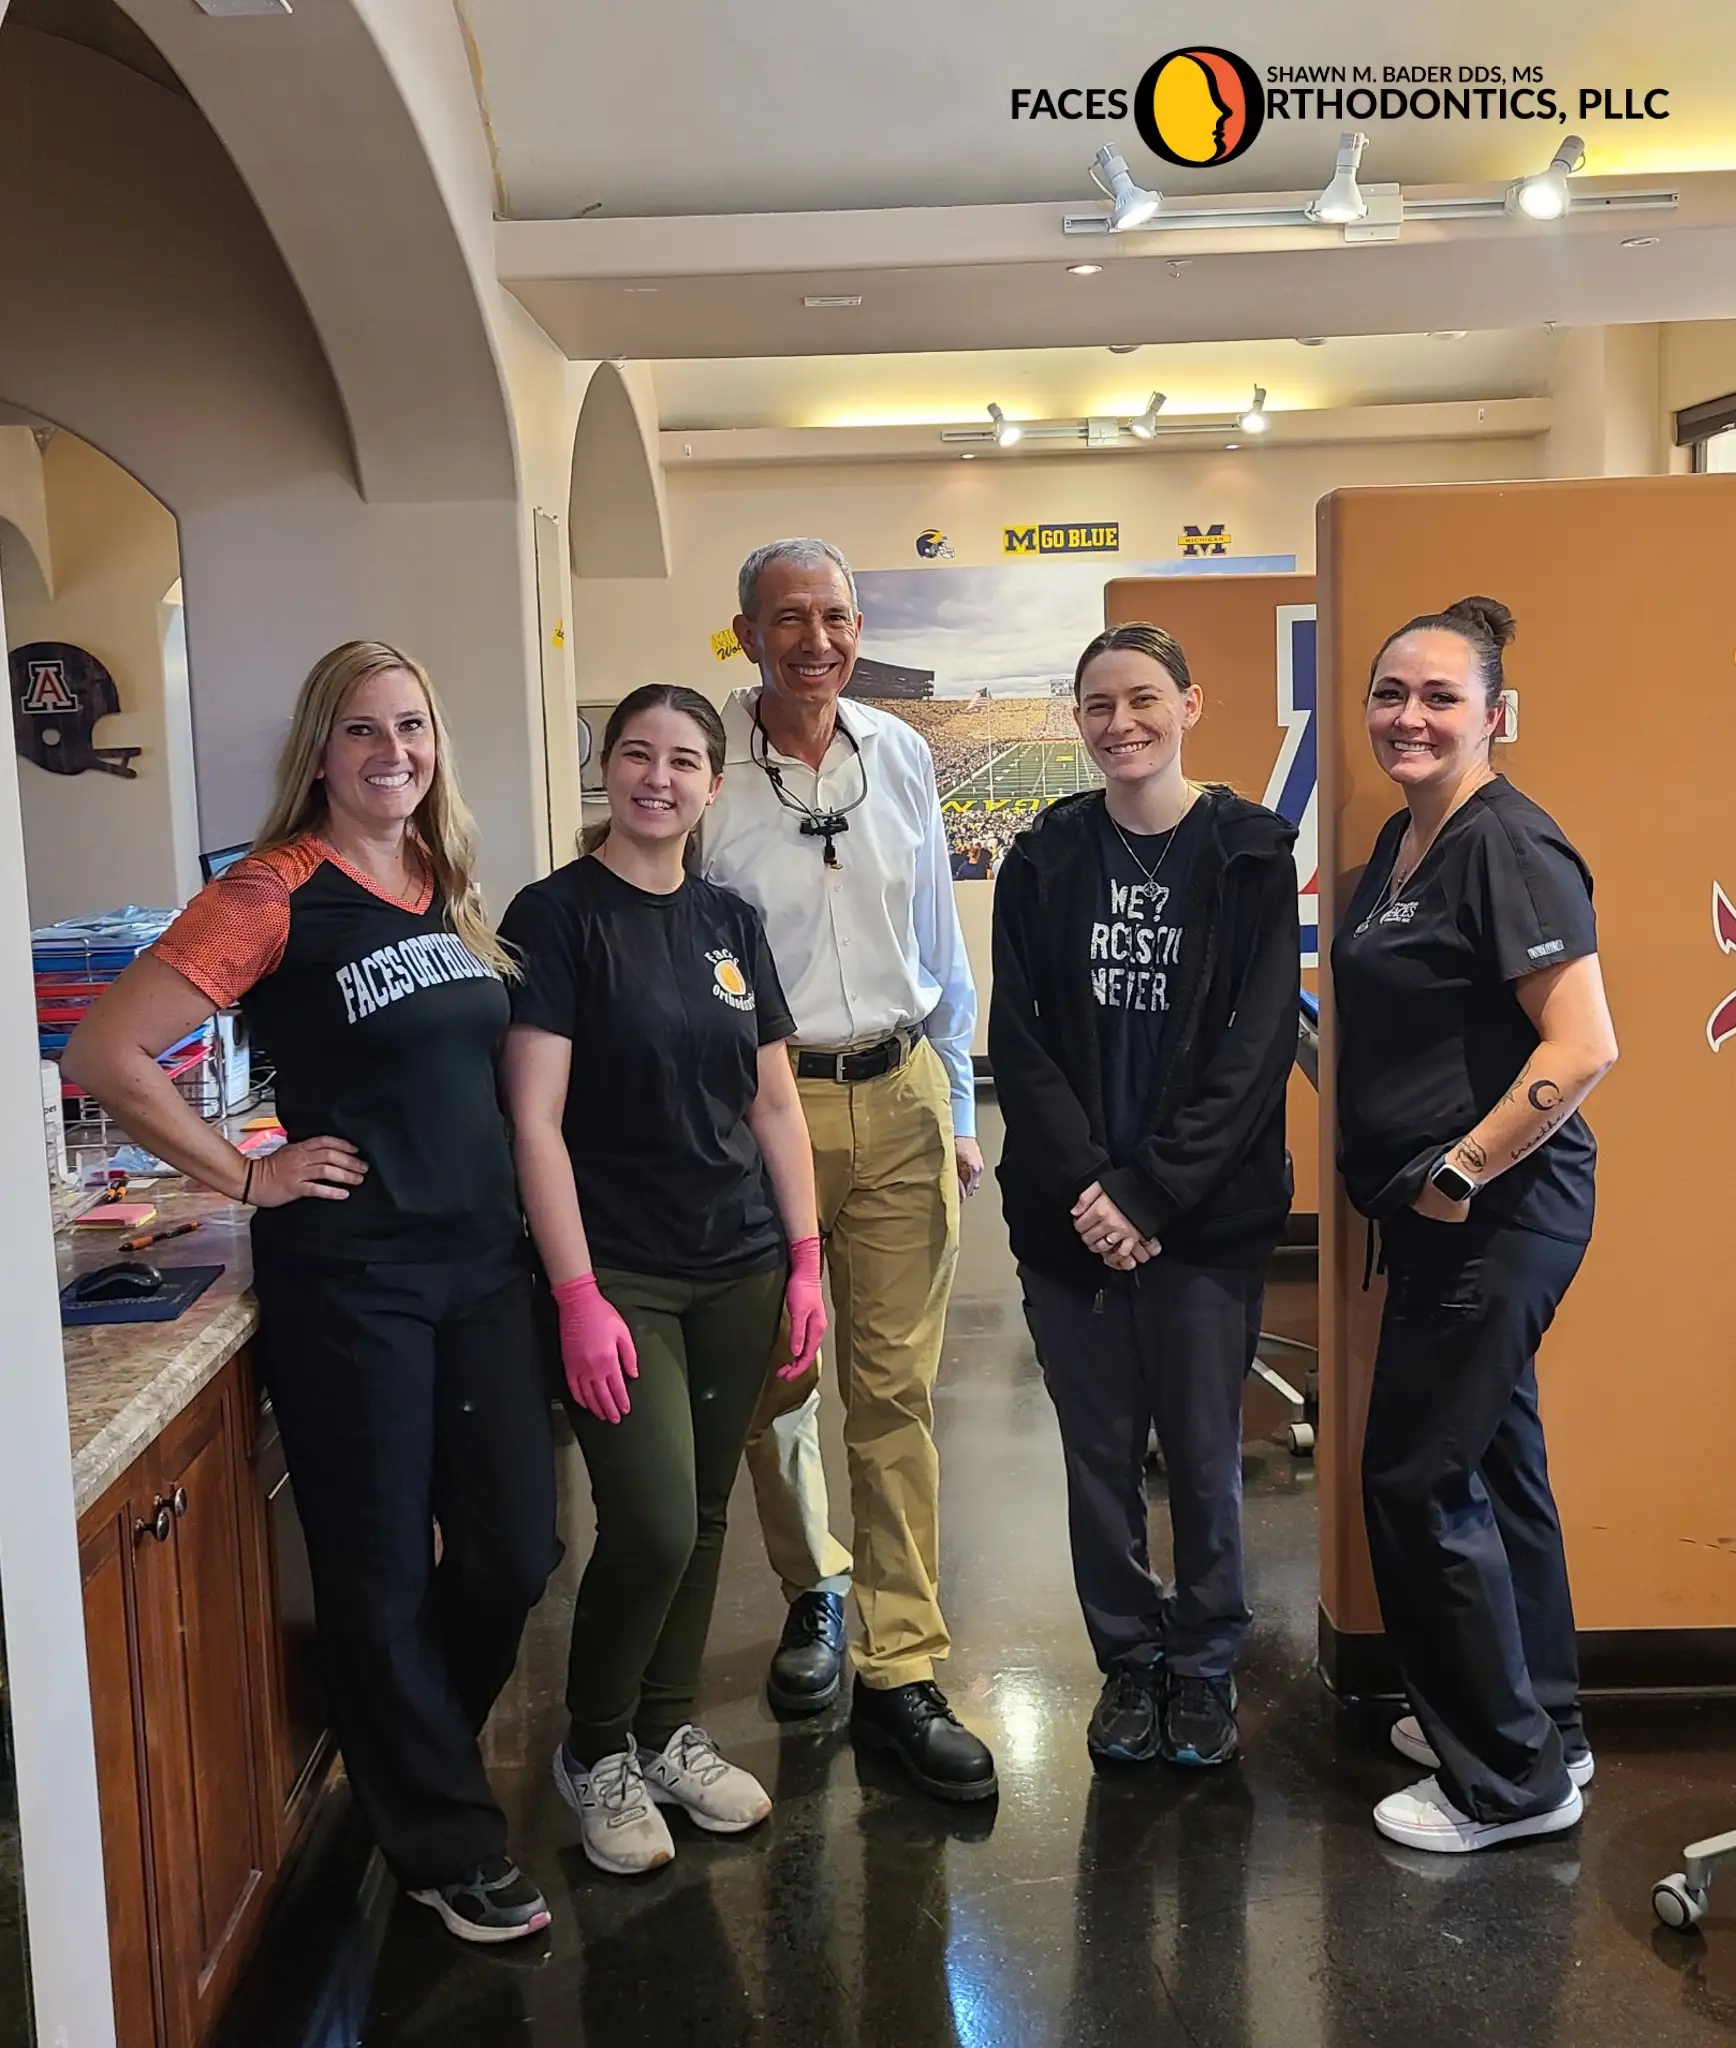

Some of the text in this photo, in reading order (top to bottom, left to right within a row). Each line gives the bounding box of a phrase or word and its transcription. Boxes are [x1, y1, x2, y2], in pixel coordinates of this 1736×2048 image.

[1041, 530, 1065, 549] GO
[1068, 527, 1118, 547] BLUE
[1184, 536, 1225, 544] MICHIGAN
